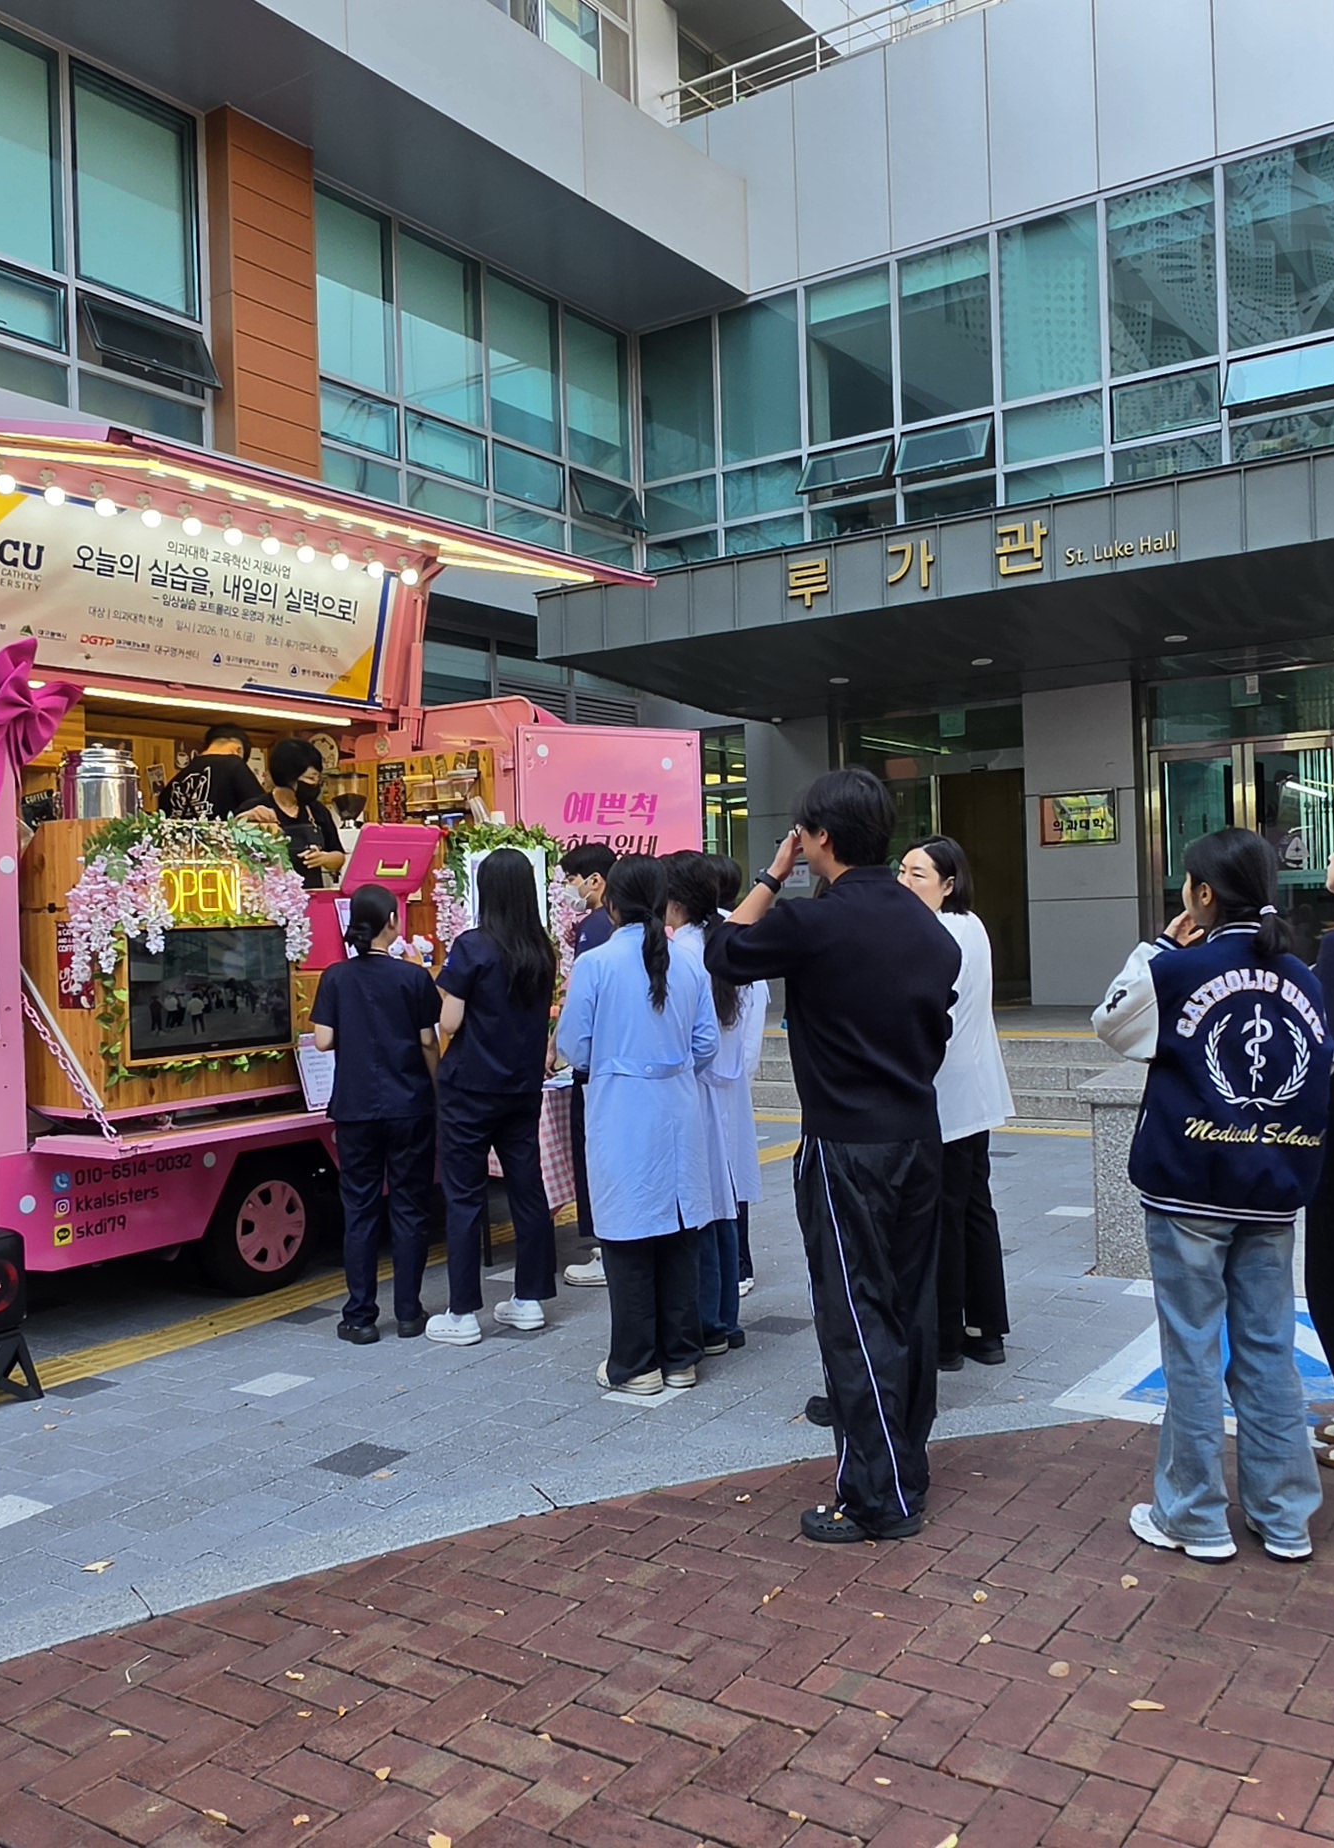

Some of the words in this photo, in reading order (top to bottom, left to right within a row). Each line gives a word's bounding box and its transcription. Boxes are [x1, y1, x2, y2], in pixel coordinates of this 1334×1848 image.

[167, 540, 209, 562] 의과대학
[211, 549, 251, 571] 교육혁신
[252, 558, 292, 580] 지원사업
[1064, 547, 1088, 566] St.
[1093, 539, 1134, 563] Luke
[1139, 530, 1177, 555] Hall
[1, 567, 42, 583] CATHOLIC
[72, 545, 141, 583] 오늘의
[148, 559, 214, 598] 실습을,
[222, 574, 278, 609] 내일의
[284, 587, 358, 625] 실력으로!
[88, 606, 105, 619] 대상
[112, 609, 147, 626] 의과대학
[148, 615, 164, 629] 학생
[162, 593, 197, 611] 임상실습
[198, 602, 240, 619] 포트폴리오
[241, 610, 265, 623] 운영과
[267, 614, 284, 628] 개선
[80, 634, 115, 648] DGTP
[176, 620, 192, 632] 일시
[197, 623, 218, 636] 2026.
[562, 791, 658, 827] 예쁜척
[159, 869, 236, 913] OPEN
[1176, 968, 1279, 1038] CATHOLIC
[1184, 1117, 1258, 1144] Medical
[1261, 1123, 1326, 1147] School
[74, 1153, 192, 1186] 010-6514-0032
[75, 1186, 160, 1213] kkalsisters
[76, 1215, 127, 1239] skdi79
